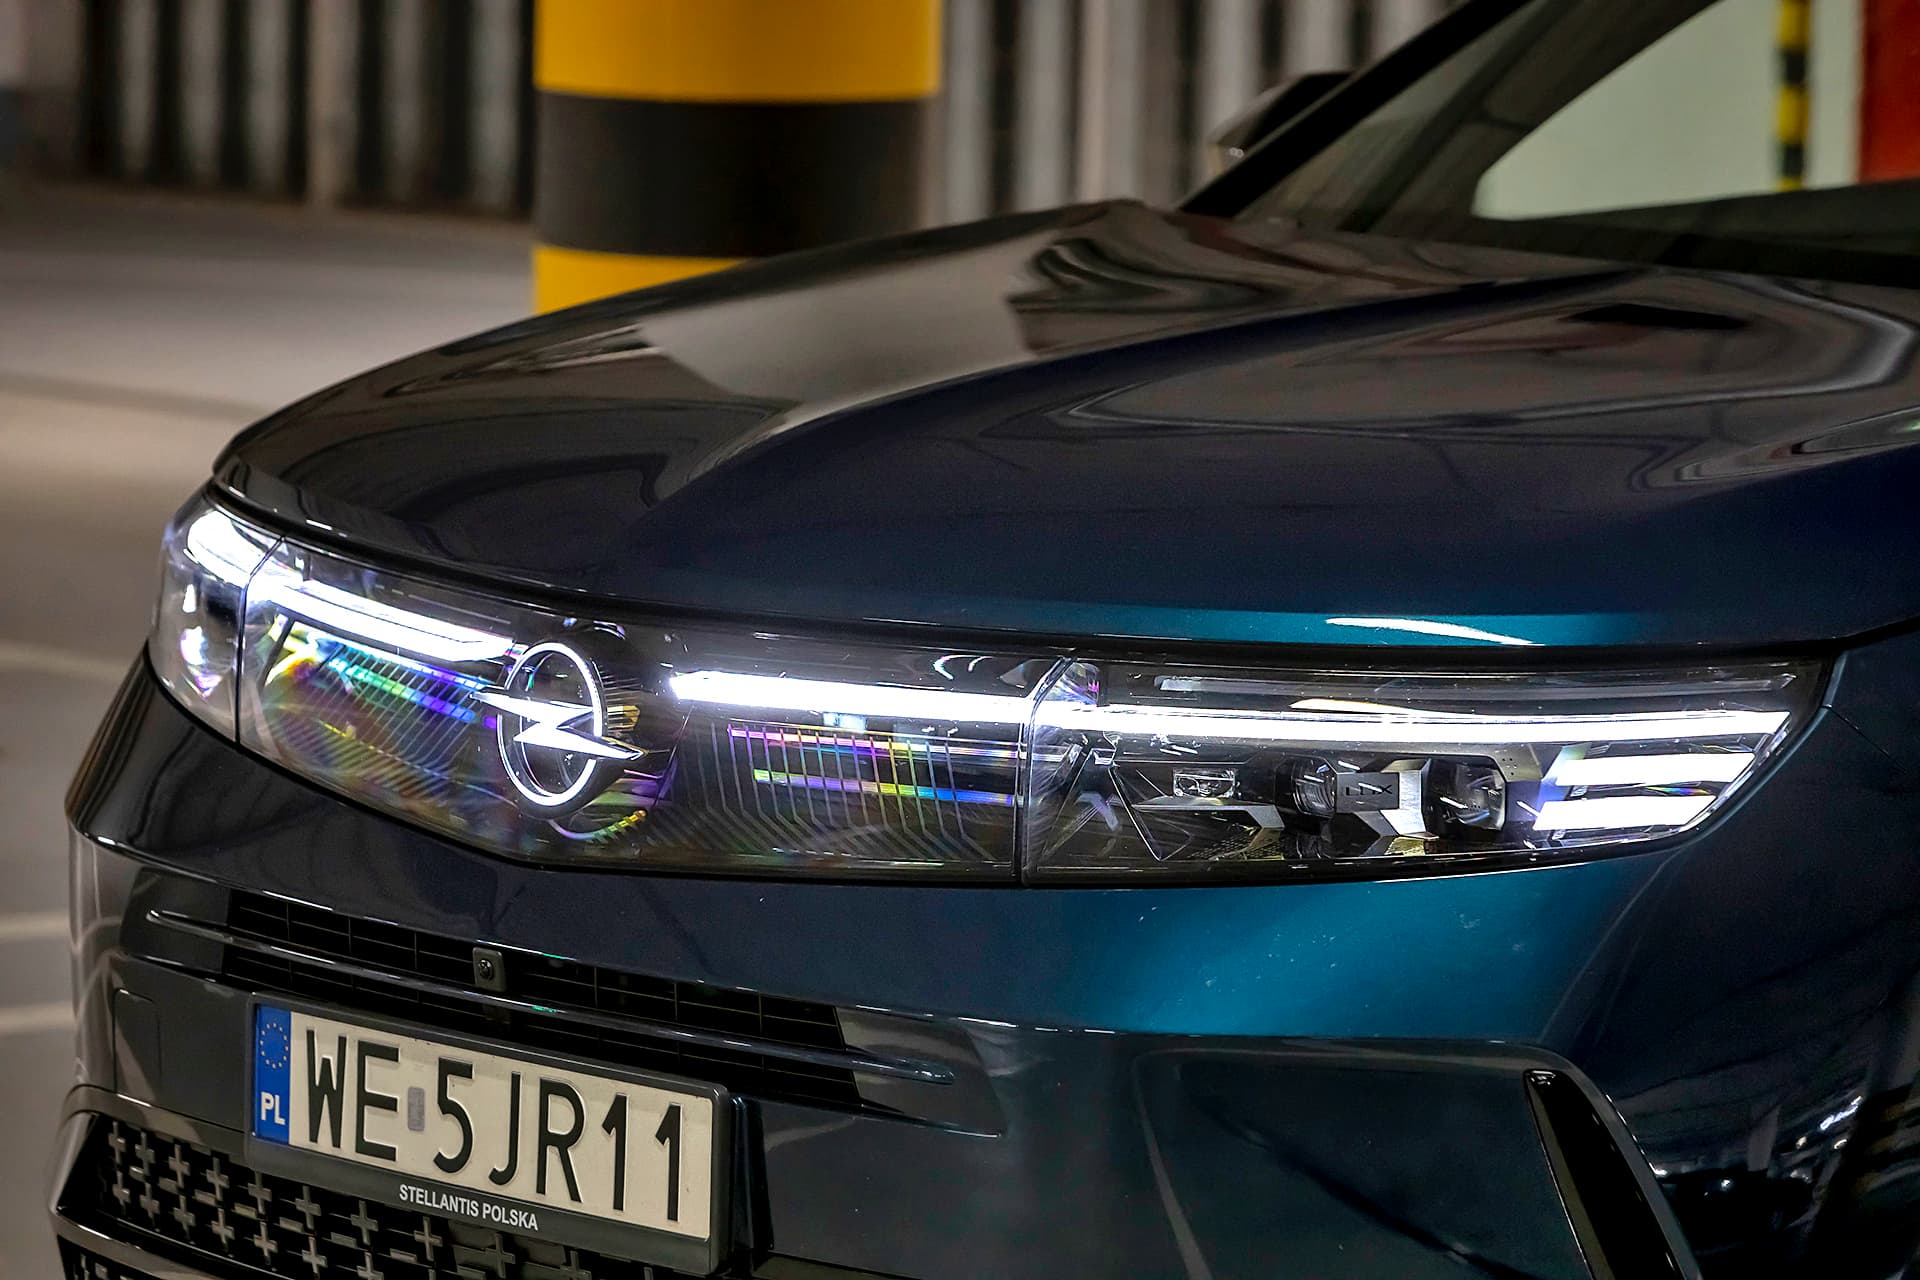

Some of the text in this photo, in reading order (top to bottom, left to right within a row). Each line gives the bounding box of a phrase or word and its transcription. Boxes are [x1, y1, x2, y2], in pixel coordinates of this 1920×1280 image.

[261, 1091, 286, 1125] PL
[306, 1029, 682, 1223] WE 5JR11
[400, 1184, 539, 1231] STELLANTIS POLSKA
